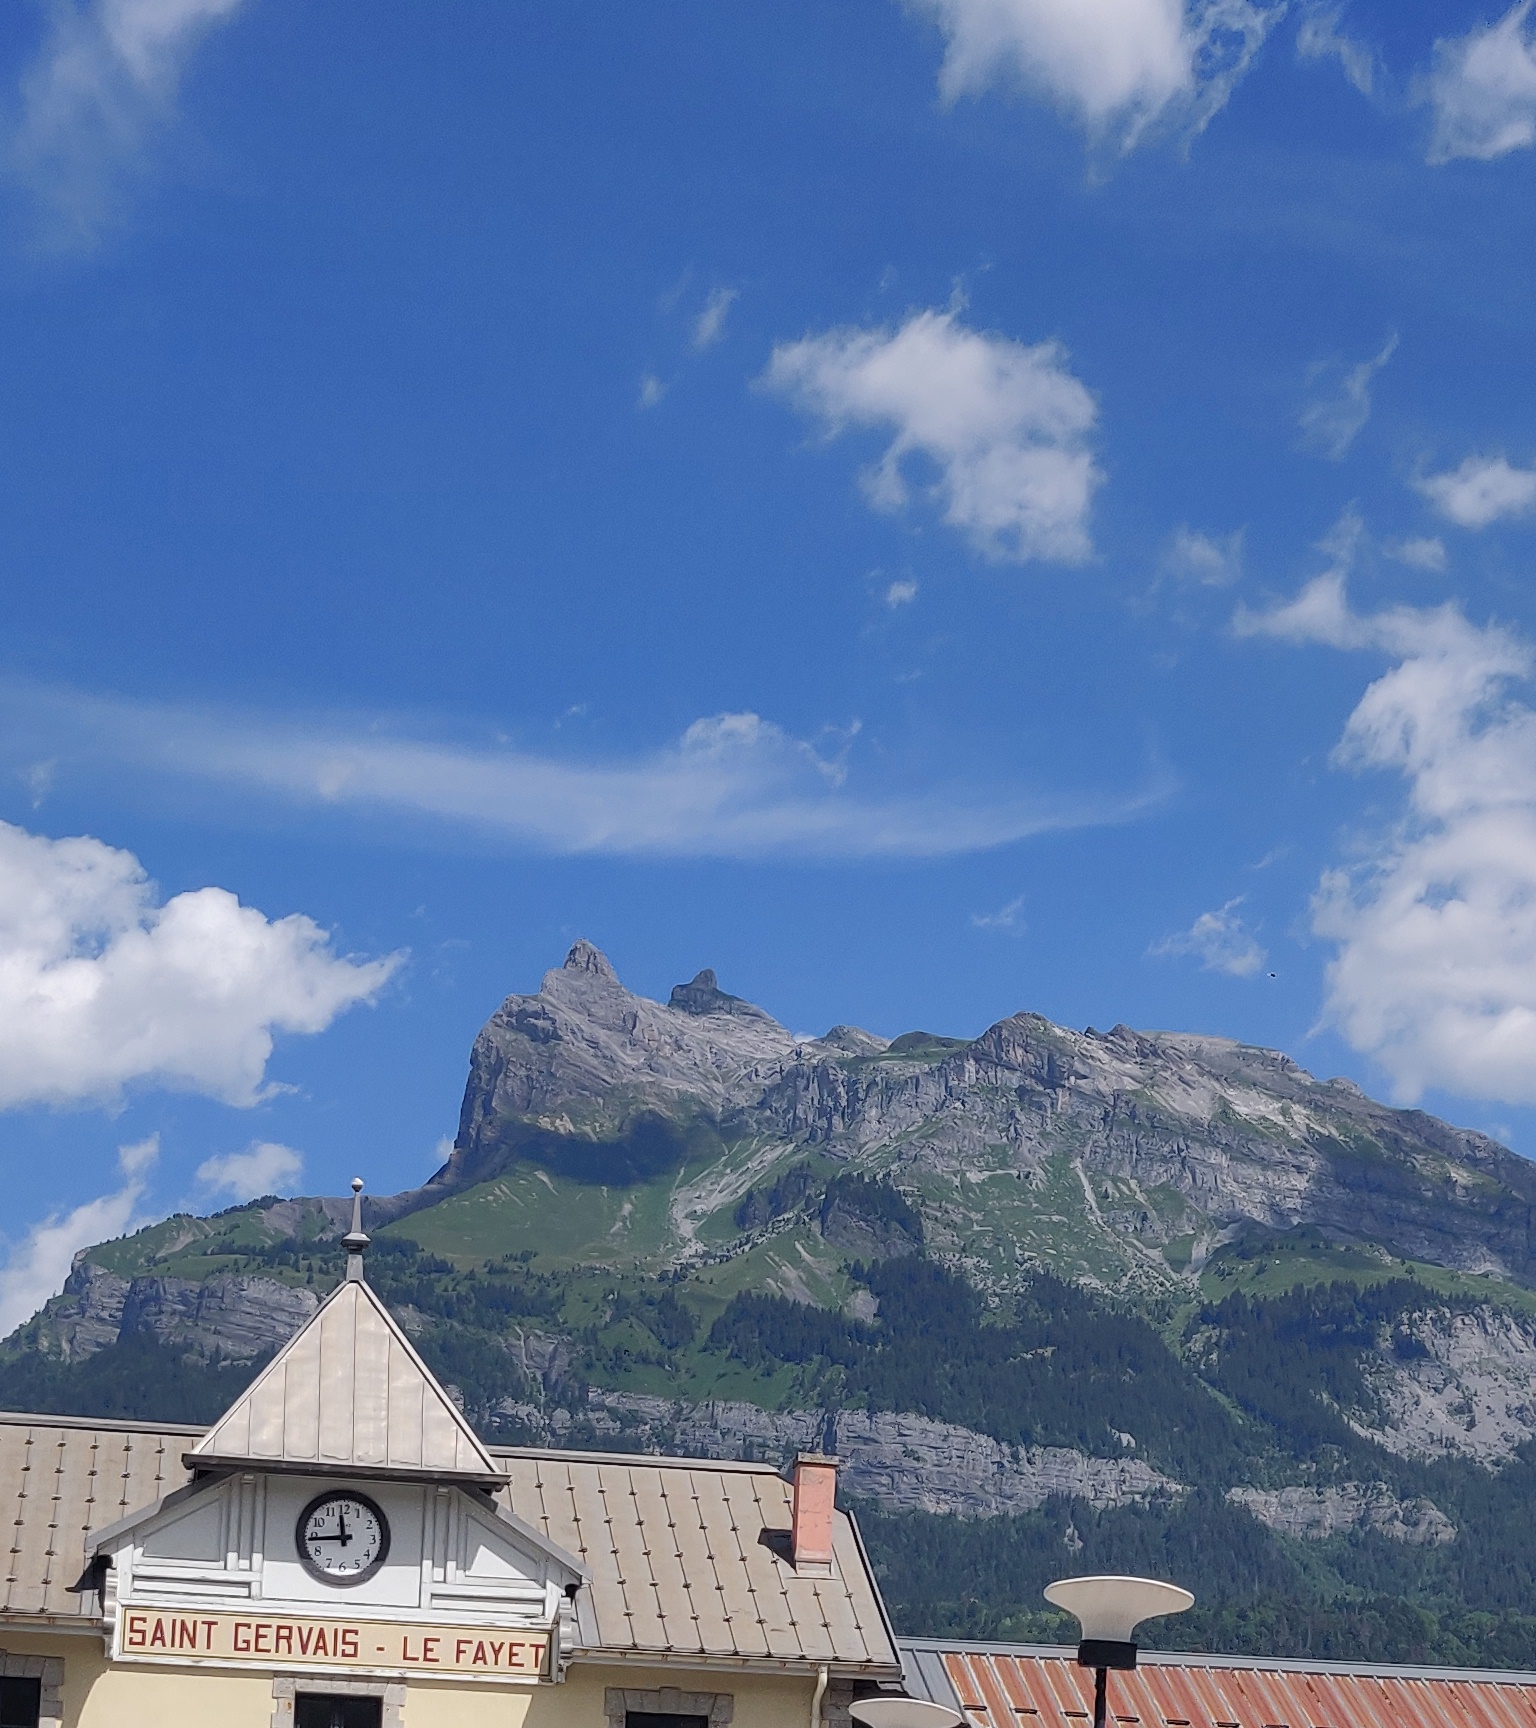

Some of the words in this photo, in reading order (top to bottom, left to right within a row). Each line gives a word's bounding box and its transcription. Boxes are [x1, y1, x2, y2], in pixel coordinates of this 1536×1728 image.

[325, 1506, 335, 1517] 11
[338, 1504, 351, 1515] 12
[313, 1517, 325, 1527] 10
[366, 1519, 373, 1530] 2
[369, 1534, 376, 1545] 3
[314, 1545, 322, 1556] 8
[363, 1548, 370, 1560] 4
[325, 1558, 332, 1568] 7
[338, 1561, 346, 1572] 6
[354, 1559, 361, 1570] 5
[128, 1615, 219, 1650] SAINT
[233, 1621, 360, 1658] GERVAIS
[402, 1635, 441, 1663] LE
[455, 1638, 547, 1669] FAYET
